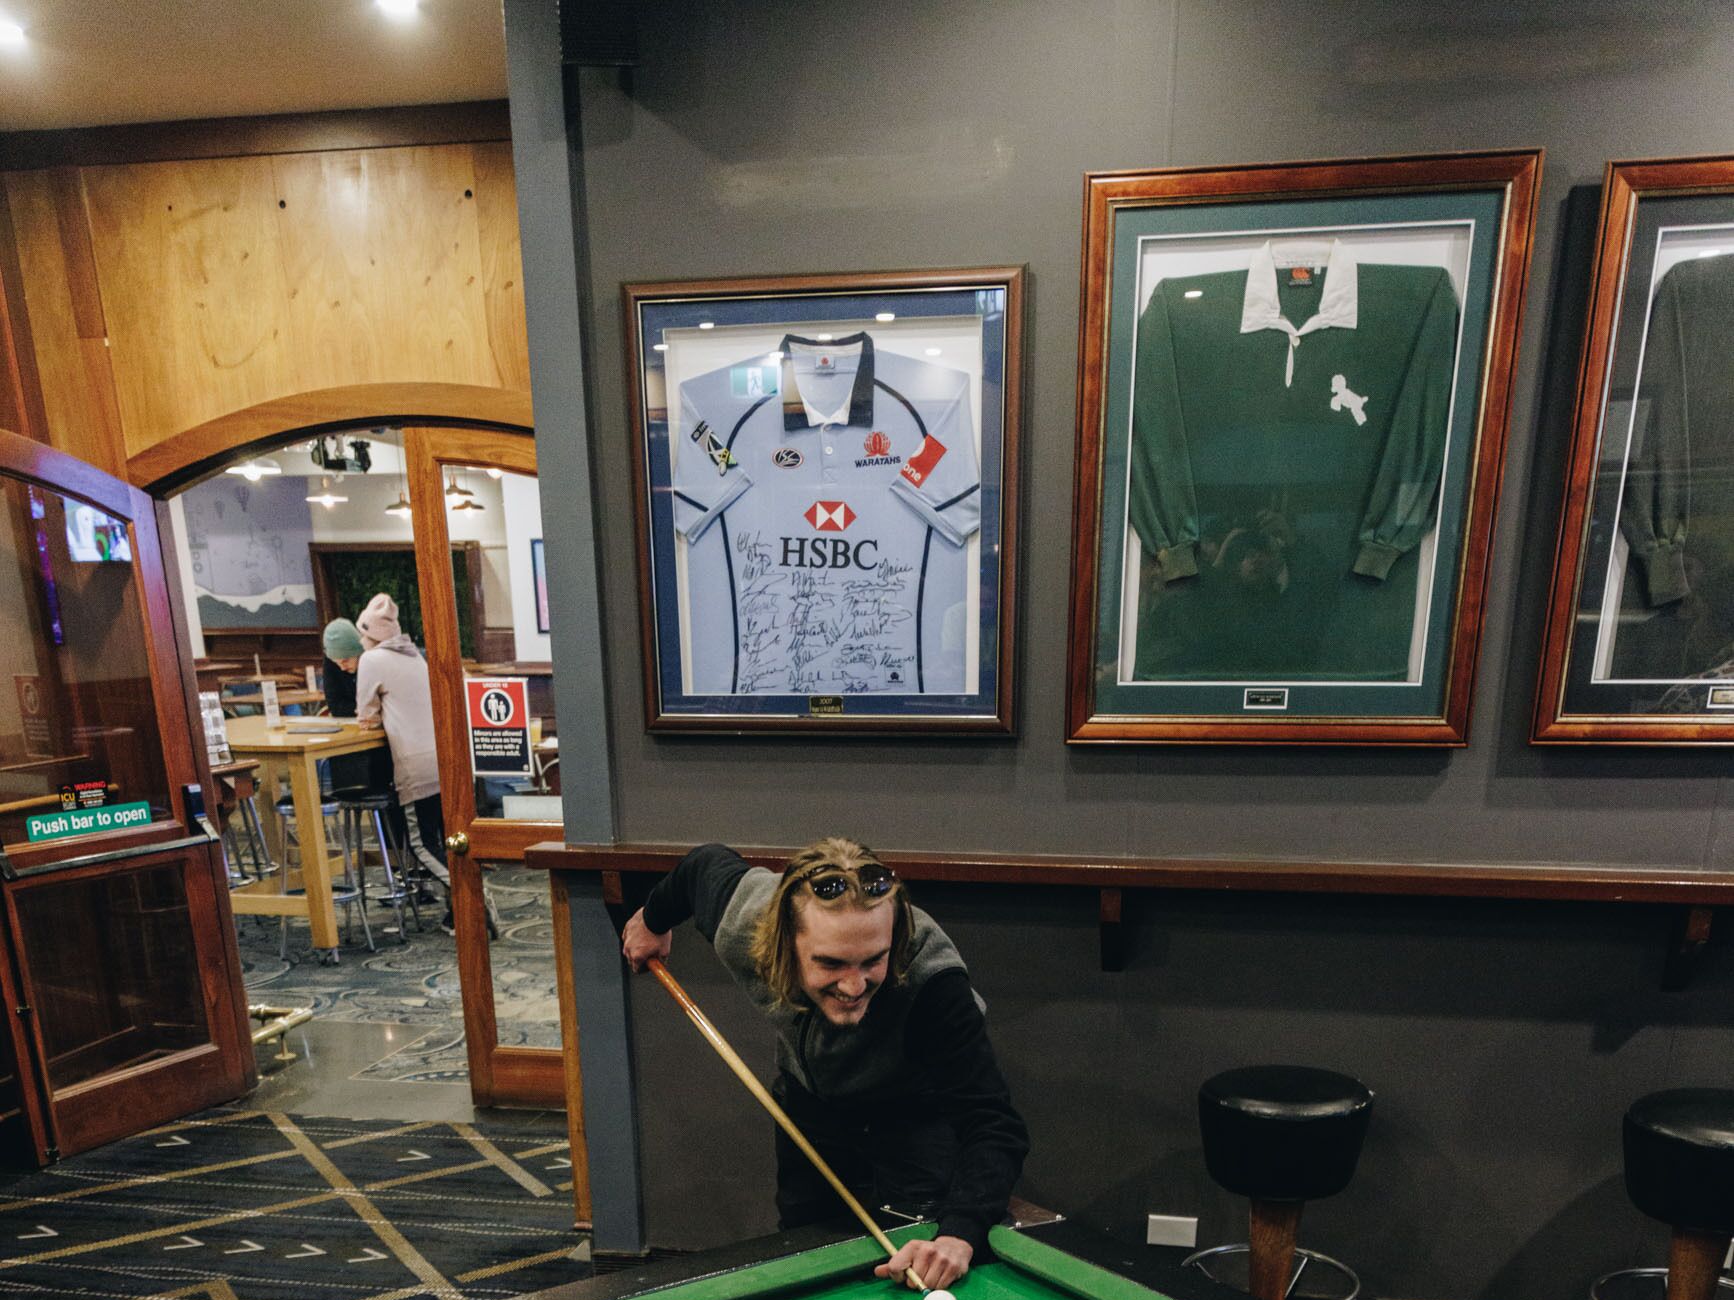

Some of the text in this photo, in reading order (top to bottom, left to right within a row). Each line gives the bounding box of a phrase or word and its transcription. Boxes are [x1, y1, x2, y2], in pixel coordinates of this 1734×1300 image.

[854, 456, 902, 468] WARATAHS
[779, 537, 878, 571] HSBC
[74, 780, 106, 790] WARNING
[61, 792, 76, 802] ICU
[31, 808, 147, 836] Push bar to open
